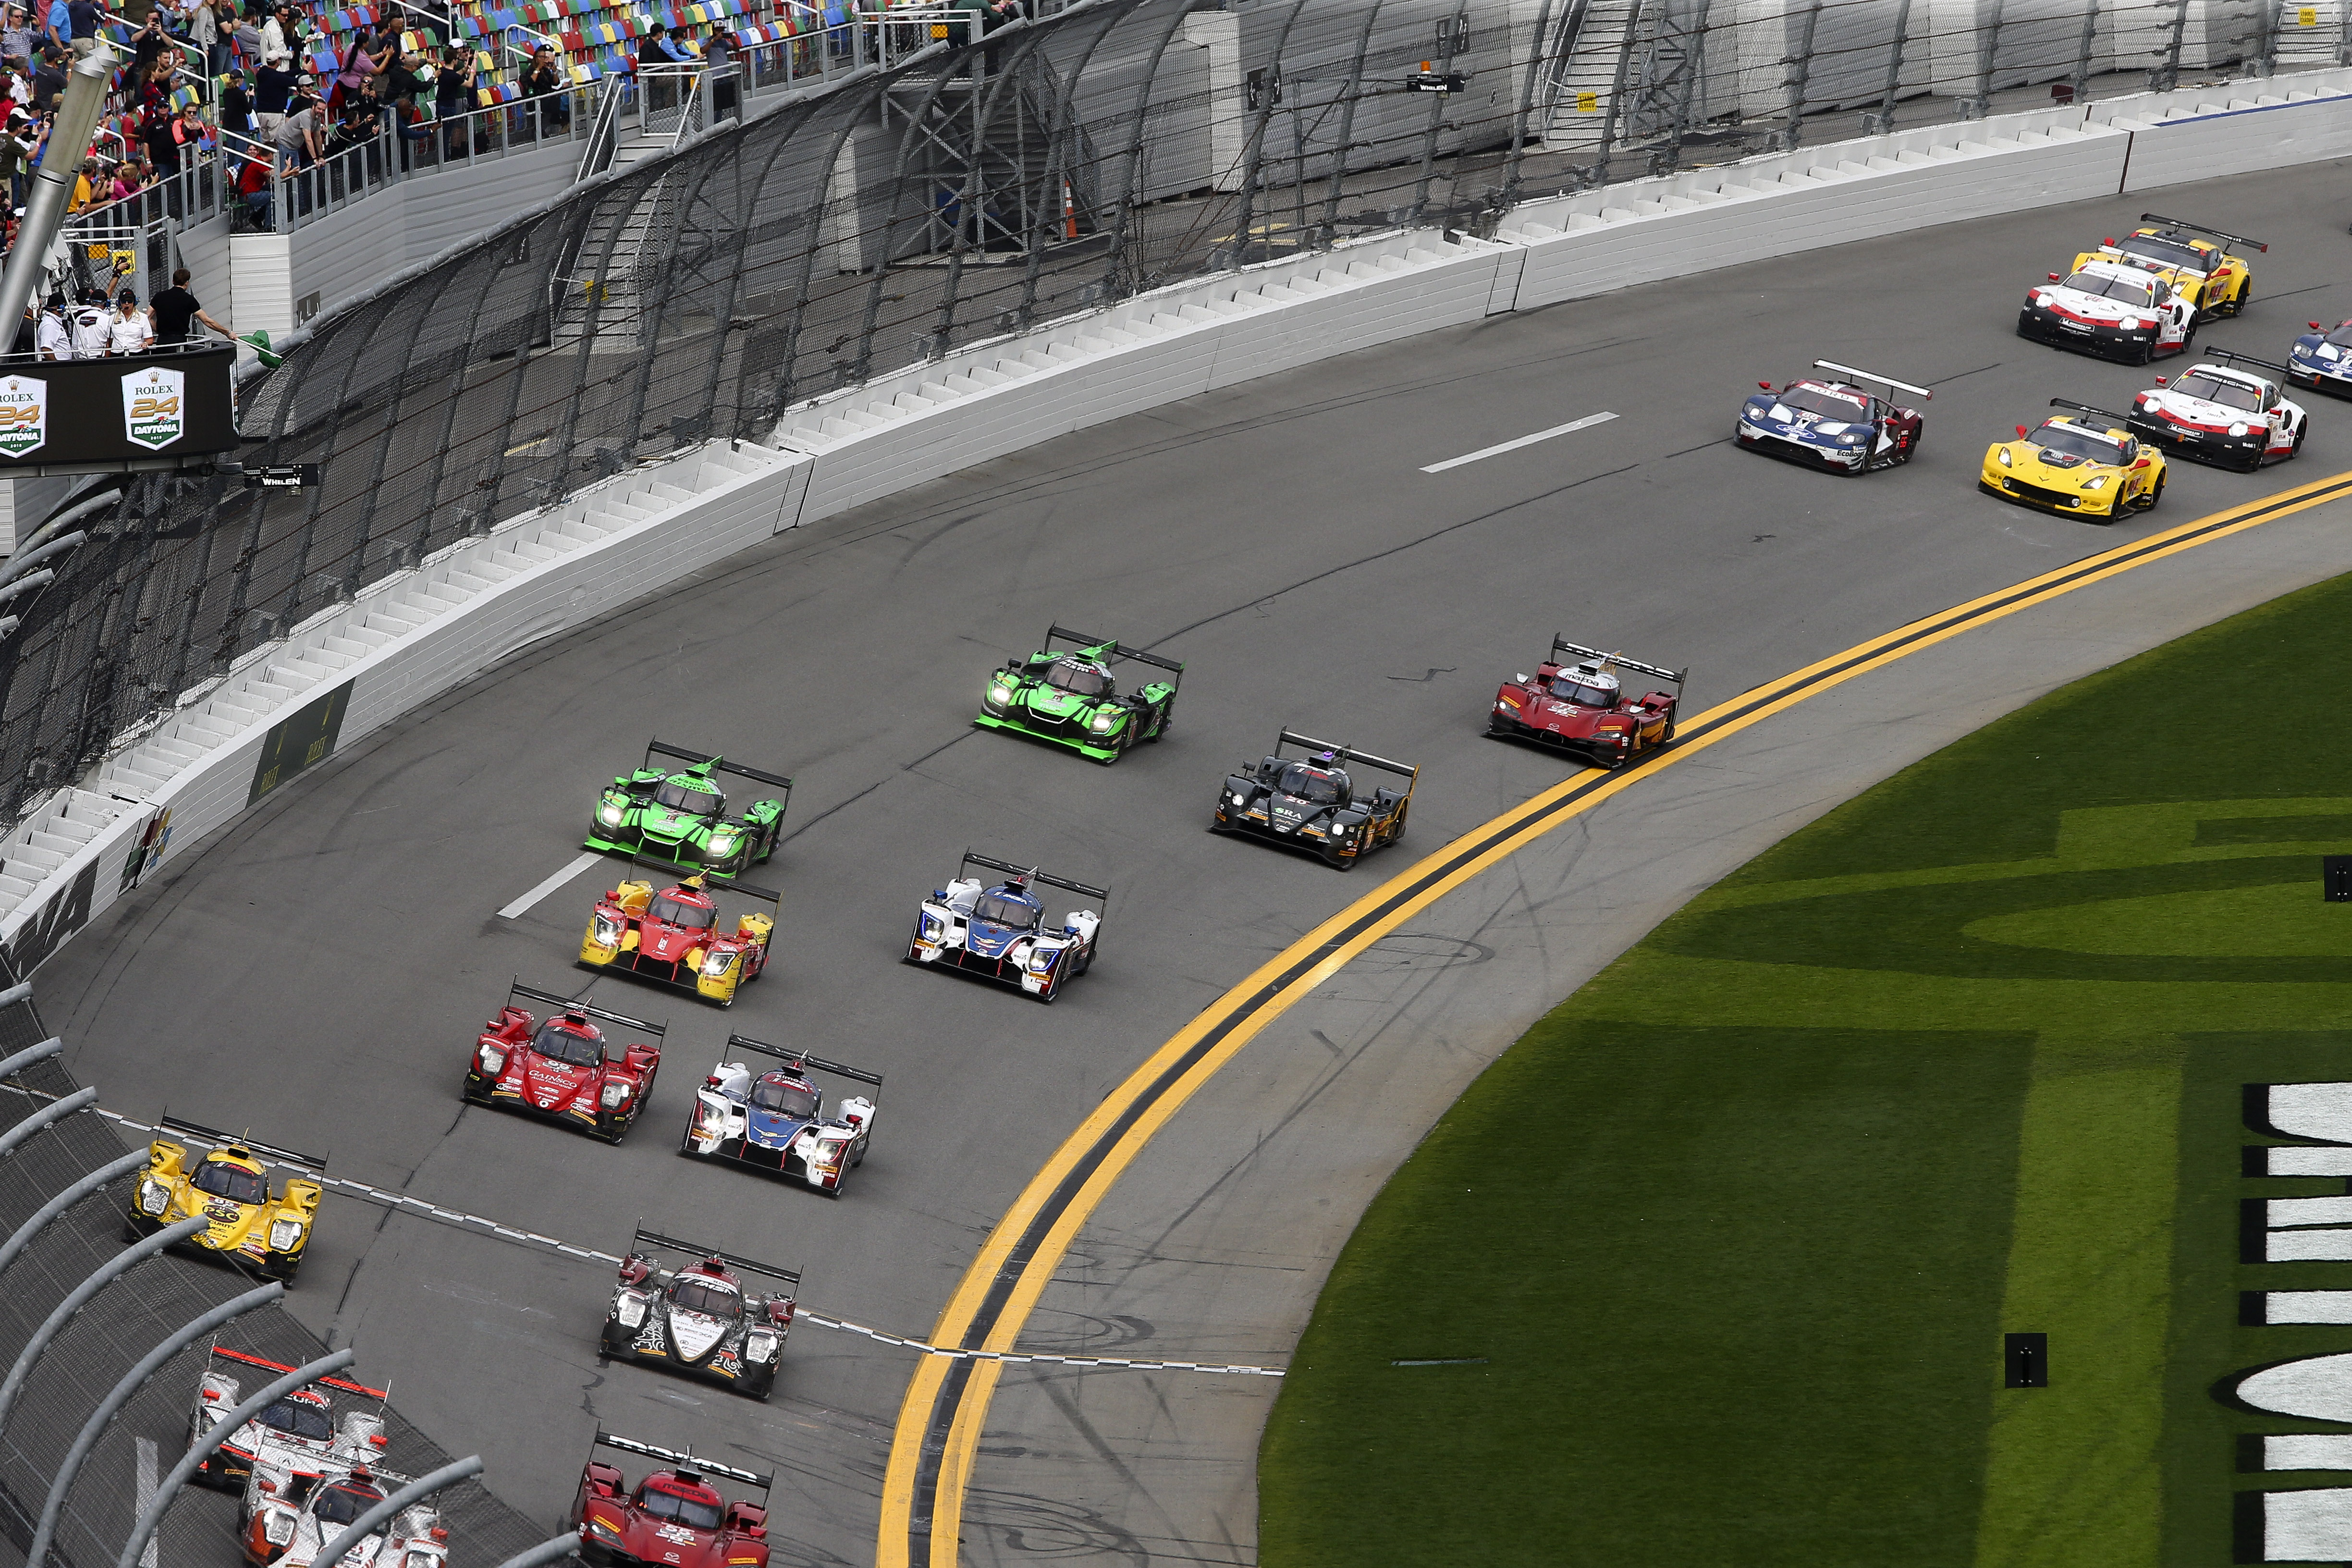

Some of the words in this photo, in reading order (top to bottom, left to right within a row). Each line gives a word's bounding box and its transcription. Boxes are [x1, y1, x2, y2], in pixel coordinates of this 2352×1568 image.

[2193, 372, 2254, 392] PORSCHE
[135, 385, 173, 395] ROLEX
[1809, 385, 1849, 401] FORD
[130, 396, 179, 418] 24
[1783, 425, 1810, 436] Ford
[262, 477, 300, 485] WHELEN
[1065, 659, 1096, 670] NISSAN
[1566, 674, 1599, 687] mazda
[304, 735, 328, 765] ROLEX
[258, 763, 281, 796] ROLEX
[1286, 795, 1307, 805] 20
[678, 894, 702, 906] IMSA
[1003, 892, 1027, 905] IMSA
[563, 1029, 589, 1041] IMSA
[528, 1070, 577, 1088] GAINSCO
[545, 1079, 573, 1090] Insurance
[781, 1079, 808, 1092] IMSA
[227, 1164, 255, 1176] IMSA
[204, 1206, 238, 1221] PSC
[695, 1281, 732, 1295] IMSA
[662, 1483, 709, 1500] mazda
[595, 1516, 617, 1531] Continental
